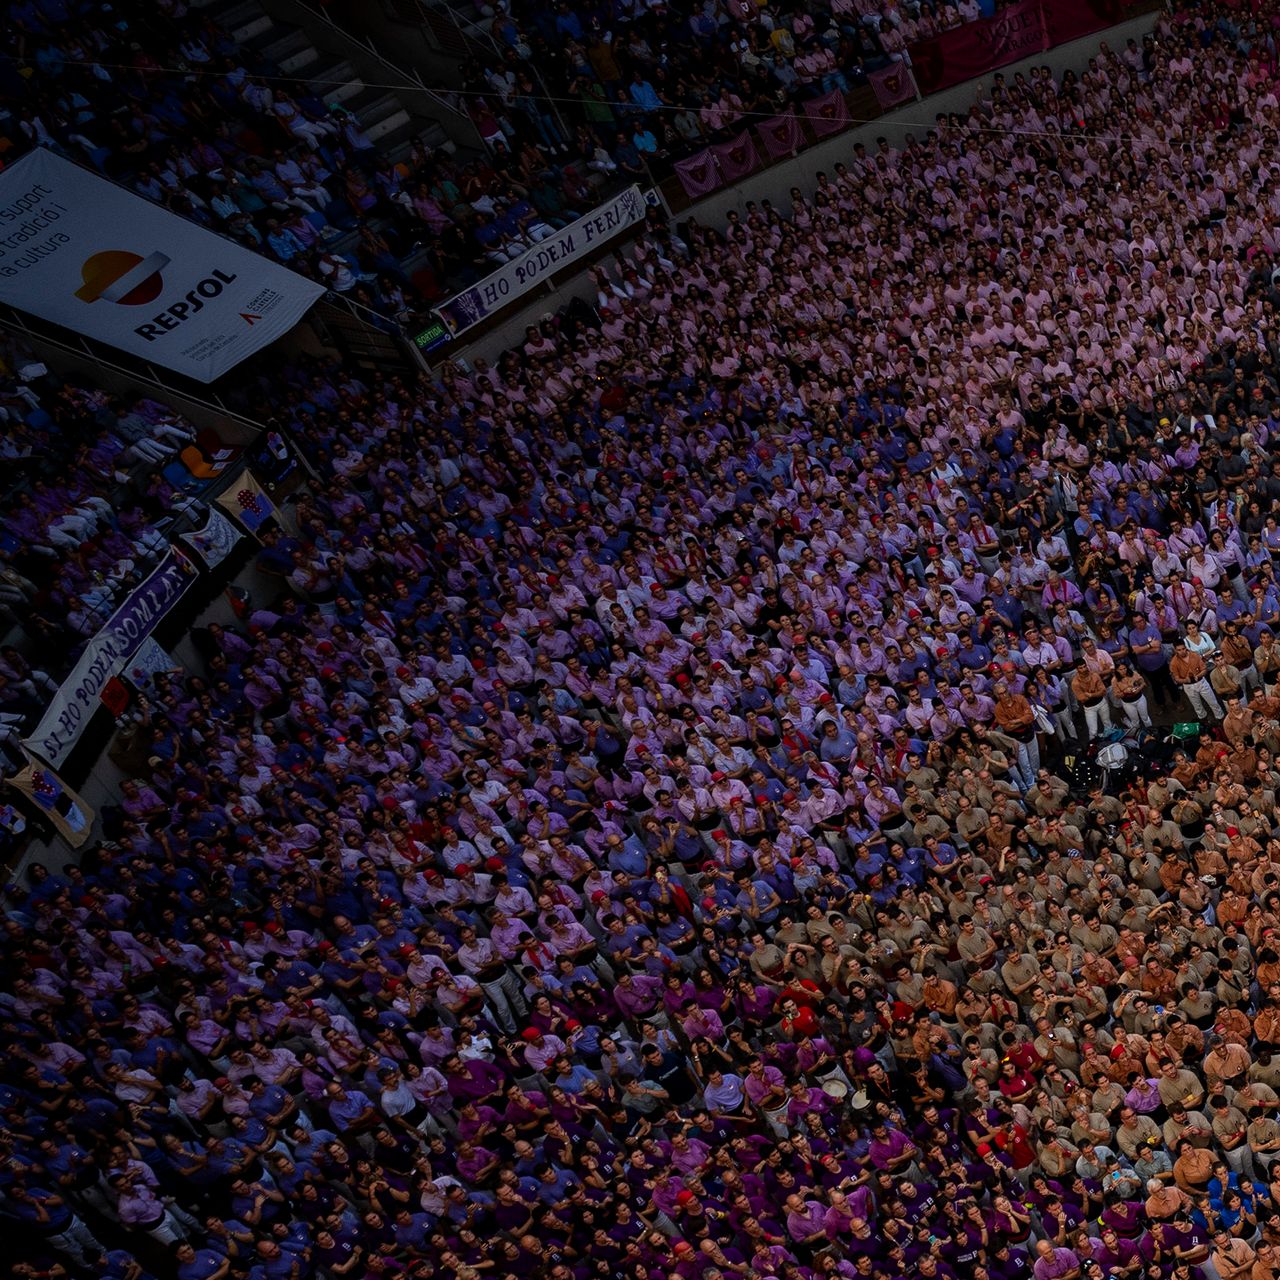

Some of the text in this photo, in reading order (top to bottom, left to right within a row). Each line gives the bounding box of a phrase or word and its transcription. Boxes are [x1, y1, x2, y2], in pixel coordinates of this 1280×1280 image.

[0, 184, 52, 221] suport
[14, 233, 70, 268] cultura
[484, 279, 510, 306] HO
[515, 235, 576, 285] PODEM
[134, 269, 237, 341] REPSOL
[416, 325, 443, 346] SORTIDA
[43, 731, 63, 760] SI
[59, 702, 81, 736] HO
[76, 641, 119, 707] PODEM
